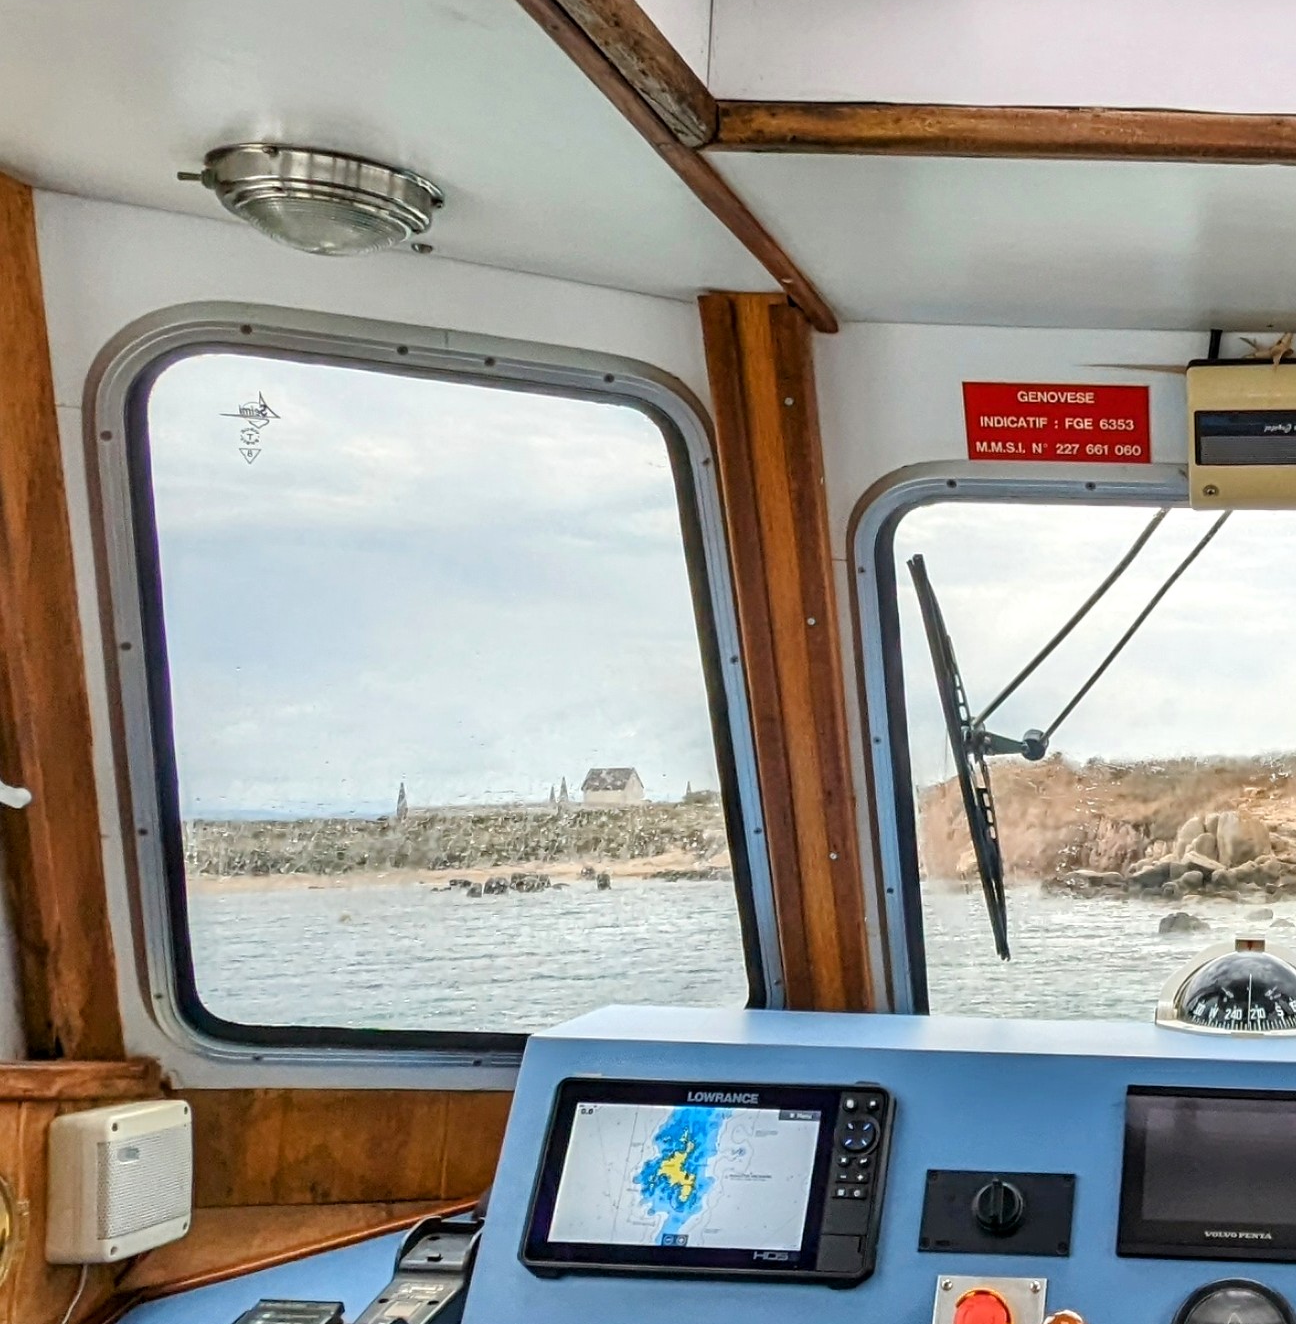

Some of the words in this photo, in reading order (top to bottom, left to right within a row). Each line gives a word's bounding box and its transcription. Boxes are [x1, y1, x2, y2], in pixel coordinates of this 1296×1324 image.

[1016, 390, 1095, 404] GENOVESE
[979, 415, 1048, 429] INDICATIF
[1064, 417, 1093, 430] FGE
[1099, 419, 1135, 431] 6353
[975, 441, 1026, 454] M.M.S.I.
[1031, 442, 1048, 454] N°
[1055, 443, 1080, 456] 227
[1085, 444, 1109, 456] 661
[1114, 444, 1142, 457] 060
[1224, 1008, 1243, 1021] 240
[686, 1091, 760, 1105] LOWRANCE
[1204, 1230, 1238, 1239] VOLVO
[1238, 1231, 1273, 1240] PENTA
